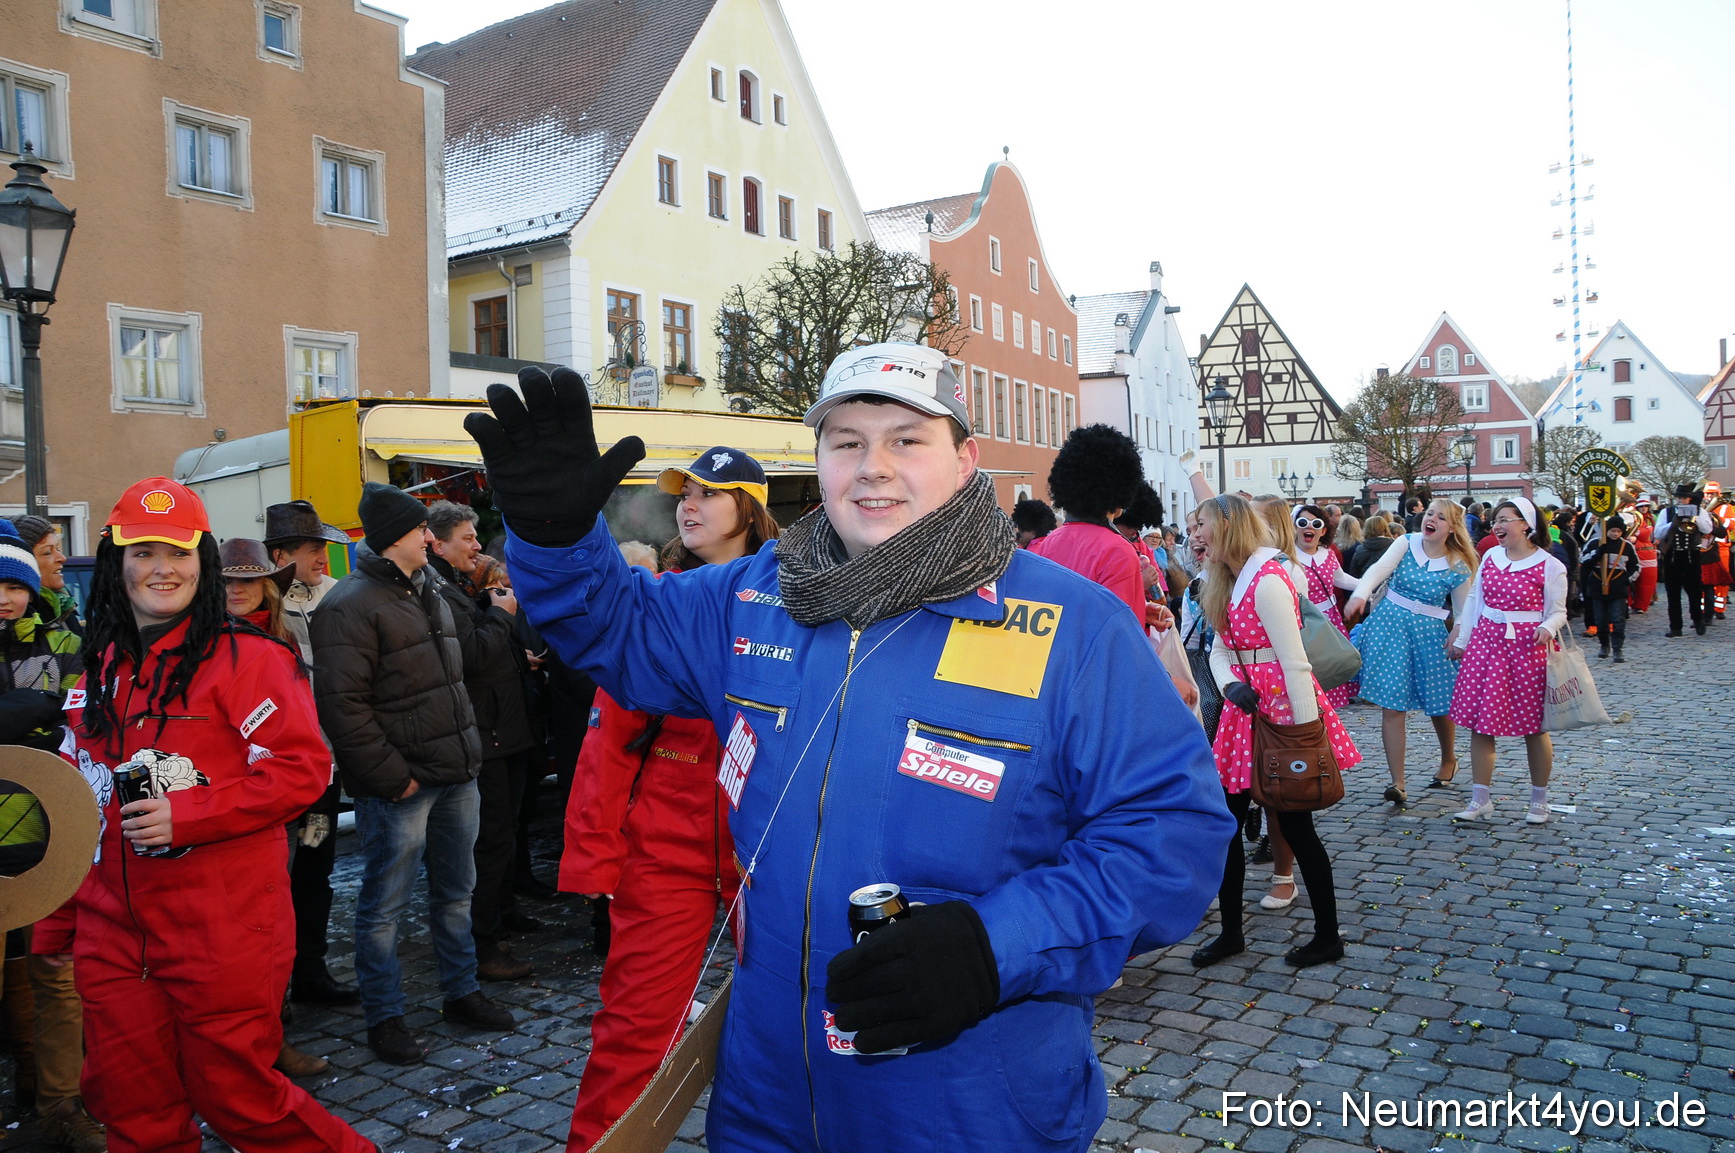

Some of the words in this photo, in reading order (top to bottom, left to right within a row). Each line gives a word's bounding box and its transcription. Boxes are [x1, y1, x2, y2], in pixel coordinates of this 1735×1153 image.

[886, 364, 926, 379] R18
[1570, 451, 1626, 474] Blaskapelle
[1581, 464, 1616, 480] Pilsach
[726, 716, 756, 775] Auto
[925, 741, 969, 763] Computer
[718, 750, 745, 807] Bild
[901, 752, 995, 794] Spiele
